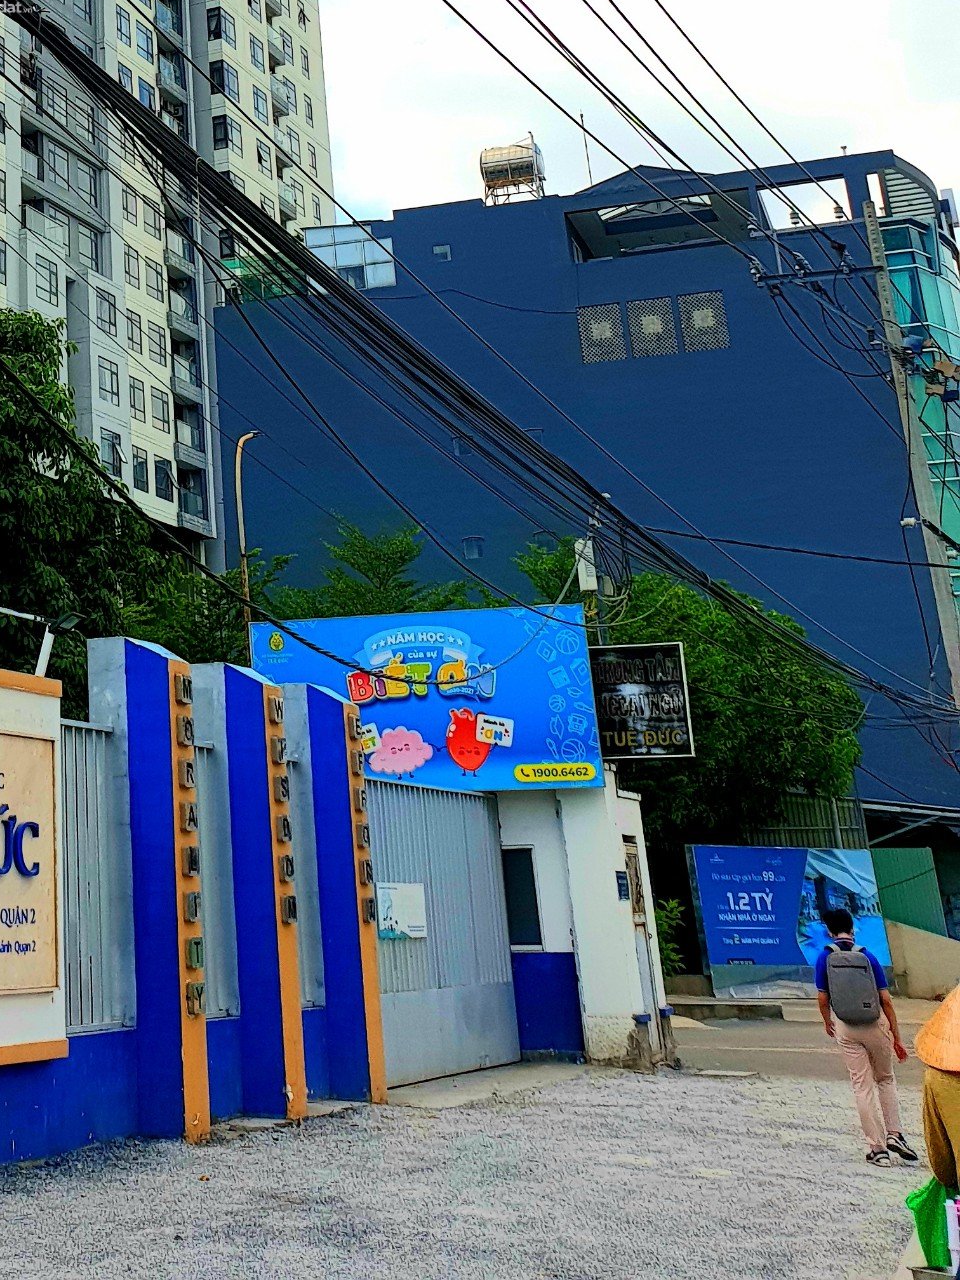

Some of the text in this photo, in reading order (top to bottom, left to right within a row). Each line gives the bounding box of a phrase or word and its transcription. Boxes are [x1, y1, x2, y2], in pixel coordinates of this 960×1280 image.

[387, 631, 445, 645] NĂM HỌC
[531, 767, 589, 777] 1900.6462
[762, 871, 775, 881] 99
[726, 888, 773, 911] 1.2 TỶ
[0, 906, 29, 928] QUẬN
[30, 908, 36, 925] 2
[734, 933, 740, 944] 2
[32, 939, 36, 952] 2
